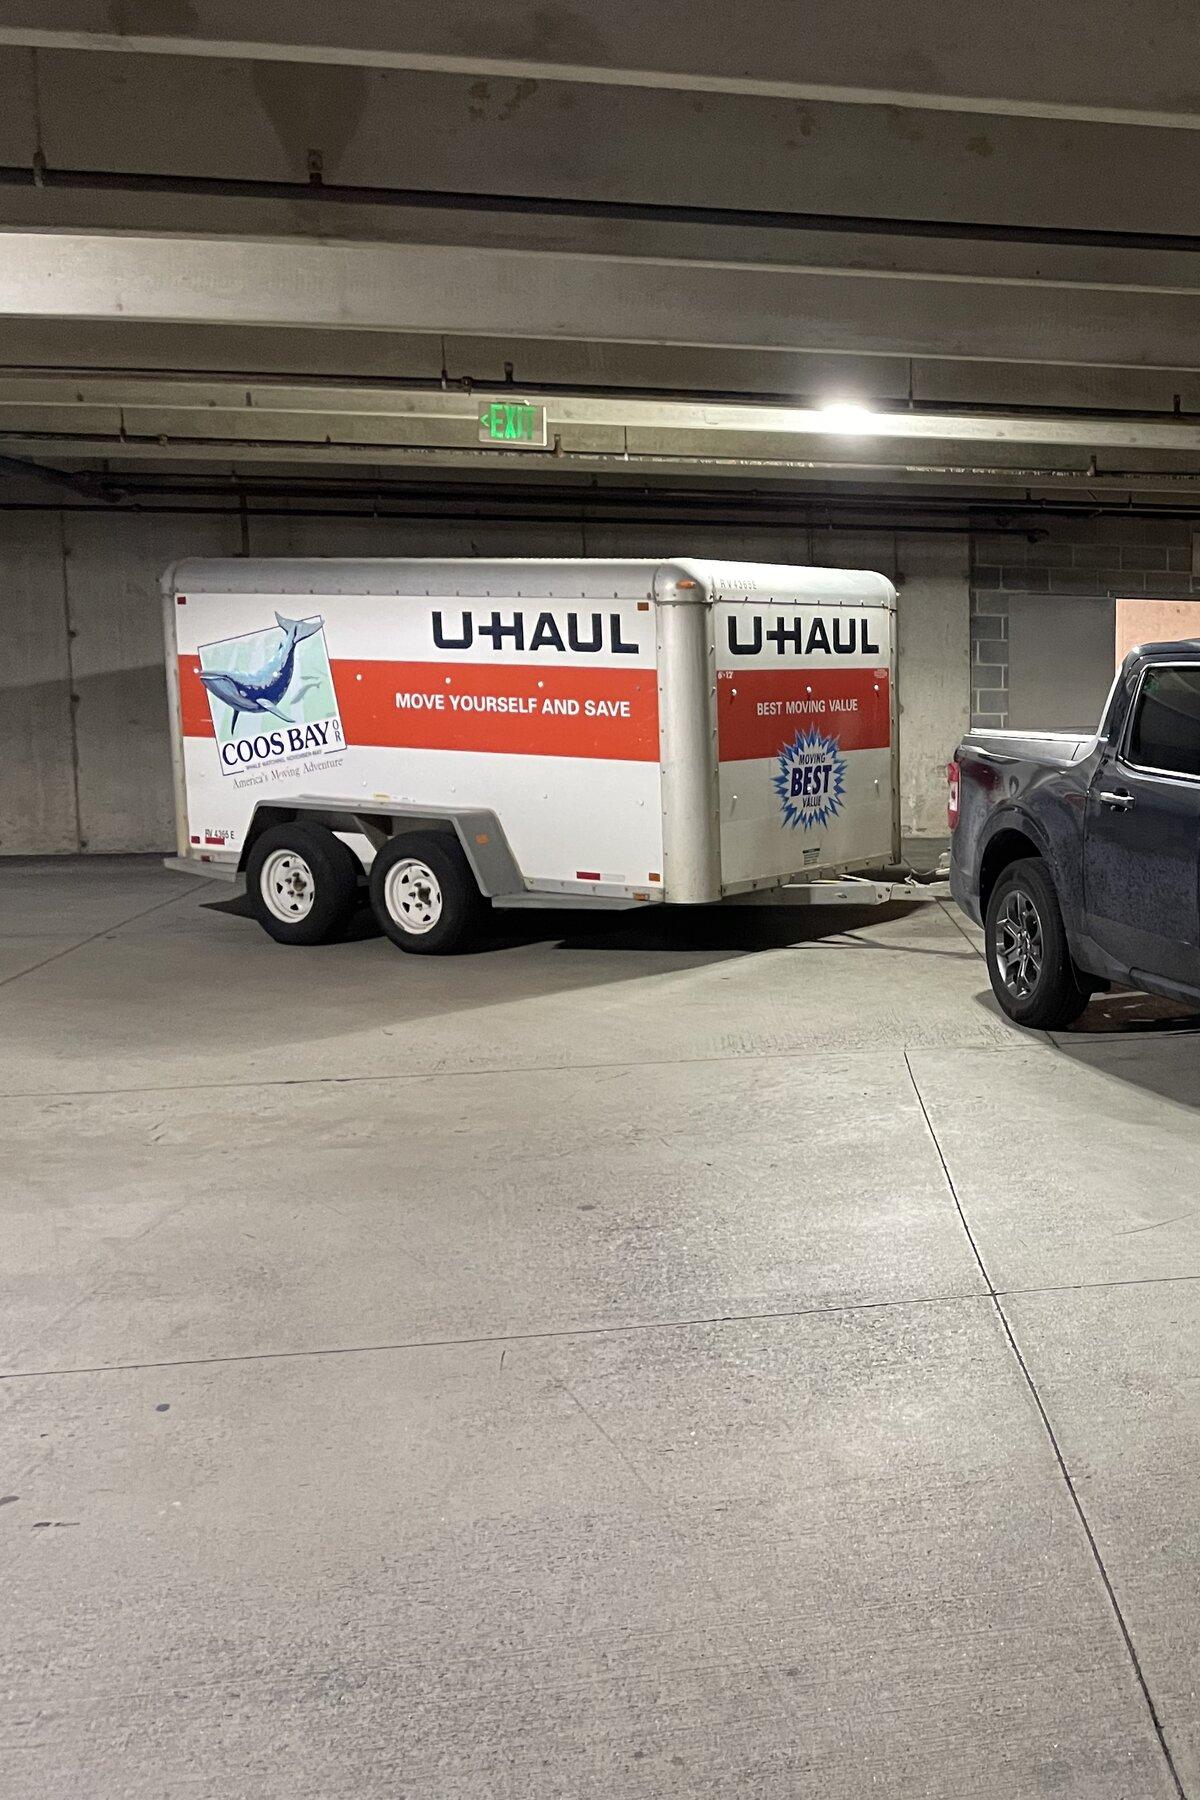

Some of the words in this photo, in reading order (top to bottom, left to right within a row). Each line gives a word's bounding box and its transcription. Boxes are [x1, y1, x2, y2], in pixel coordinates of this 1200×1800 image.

[490, 403, 537, 439] EXIT
[395, 693, 445, 710] MOVE
[449, 695, 538, 714] YOURSELF
[542, 698, 580, 716] AND
[585, 700, 630, 717] SAVE
[757, 702, 782, 716] BEST
[786, 700, 825, 715] MOVING
[829, 699, 858, 711] VALUE
[222, 732, 285, 766] COOS
[287, 721, 329, 752] BAY
[799, 754, 825, 765] MOVING
[232, 771, 269, 789] America's
[271, 767, 300, 783] Moving
[303, 759, 342, 775] Adventure
[790, 765, 832, 797] BEST
[802, 796, 821, 808] VALUE
